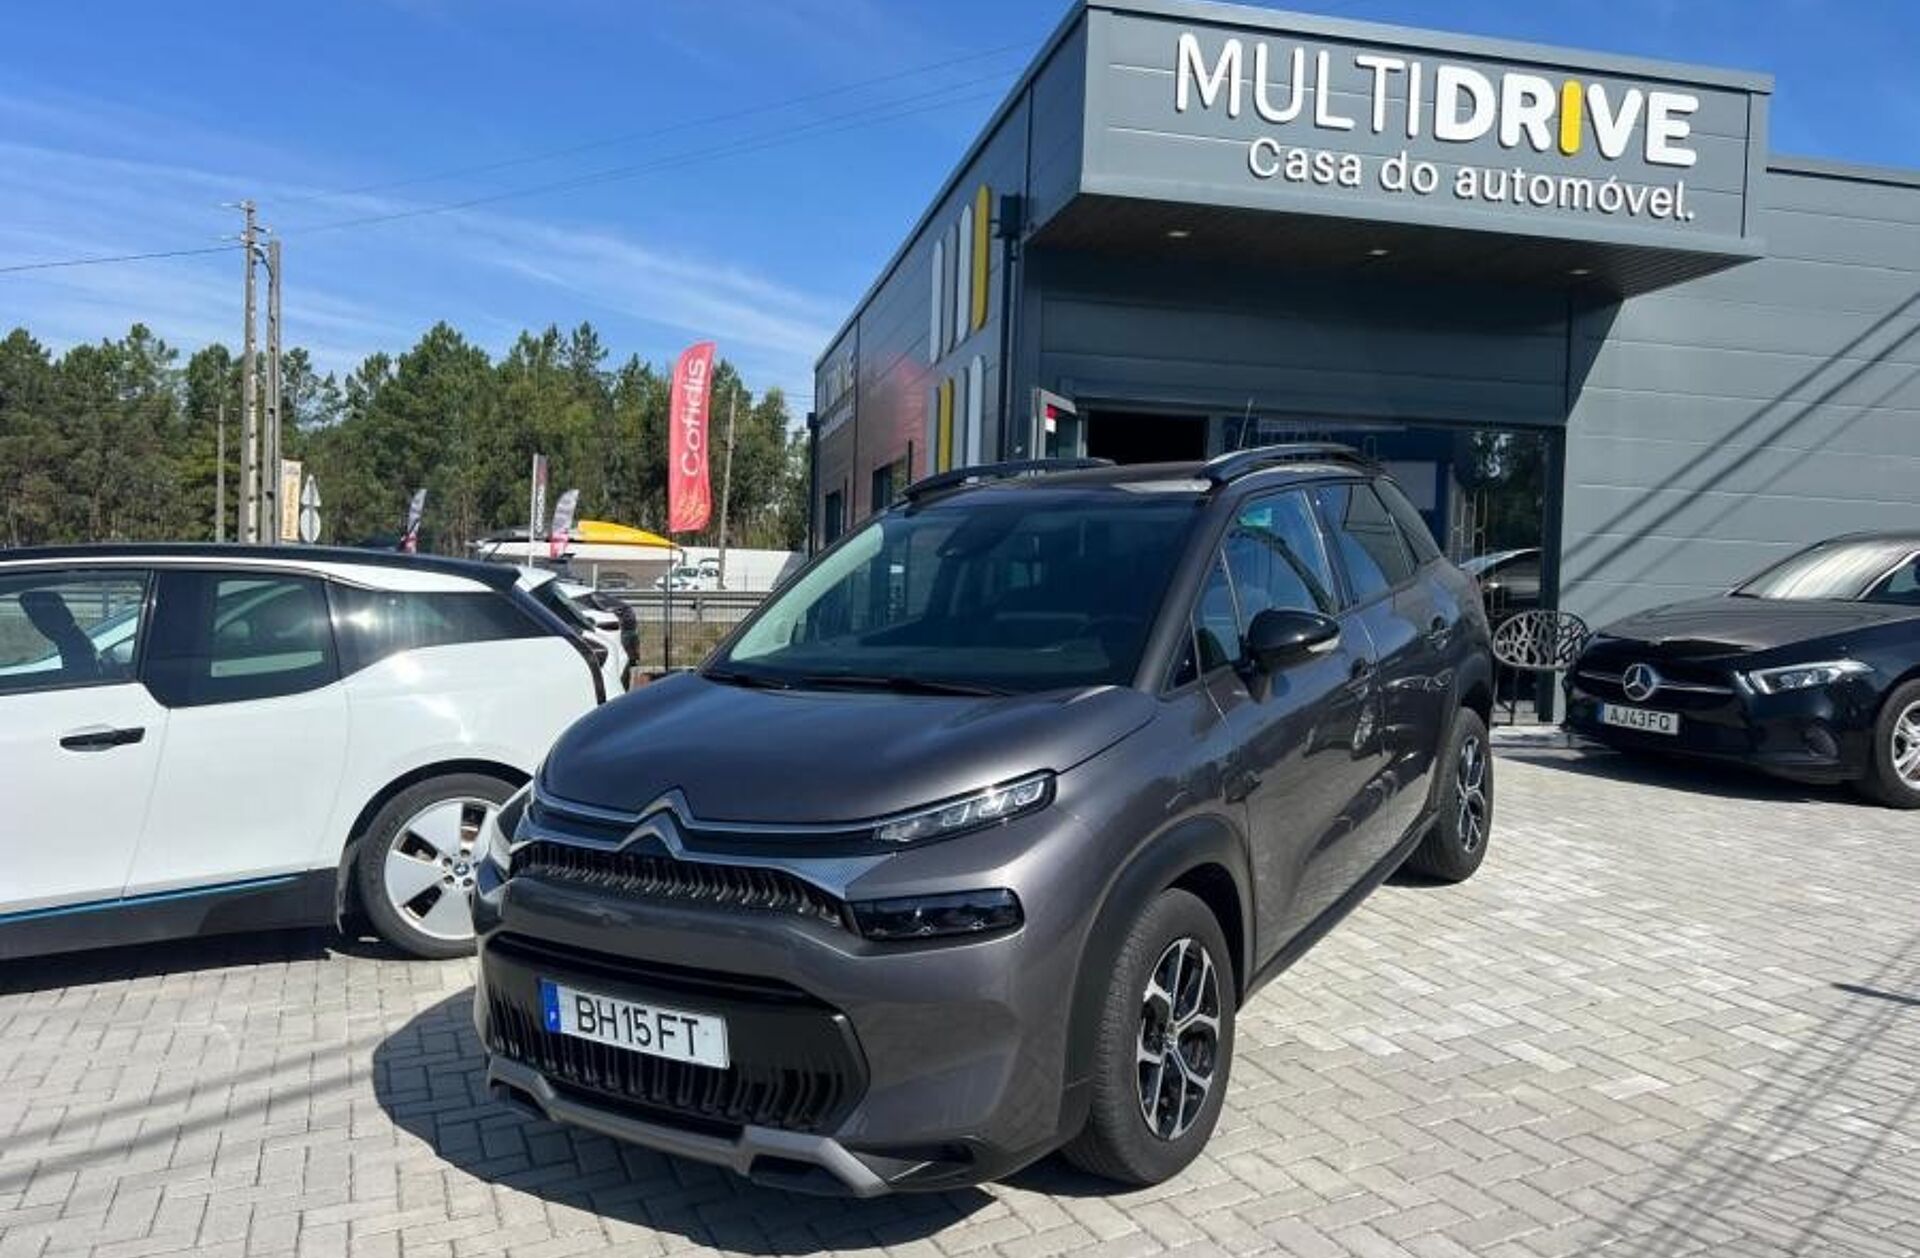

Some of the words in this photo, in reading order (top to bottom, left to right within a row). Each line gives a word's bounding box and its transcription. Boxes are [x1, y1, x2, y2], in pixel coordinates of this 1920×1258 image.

[1175, 32, 1699, 168] MULTIDRIVE
[1247, 137, 1362, 187] Casa
[1380, 151, 1439, 194] do
[1455, 167, 1695, 221] automóvel.
[680, 358, 705, 477] Cofidis
